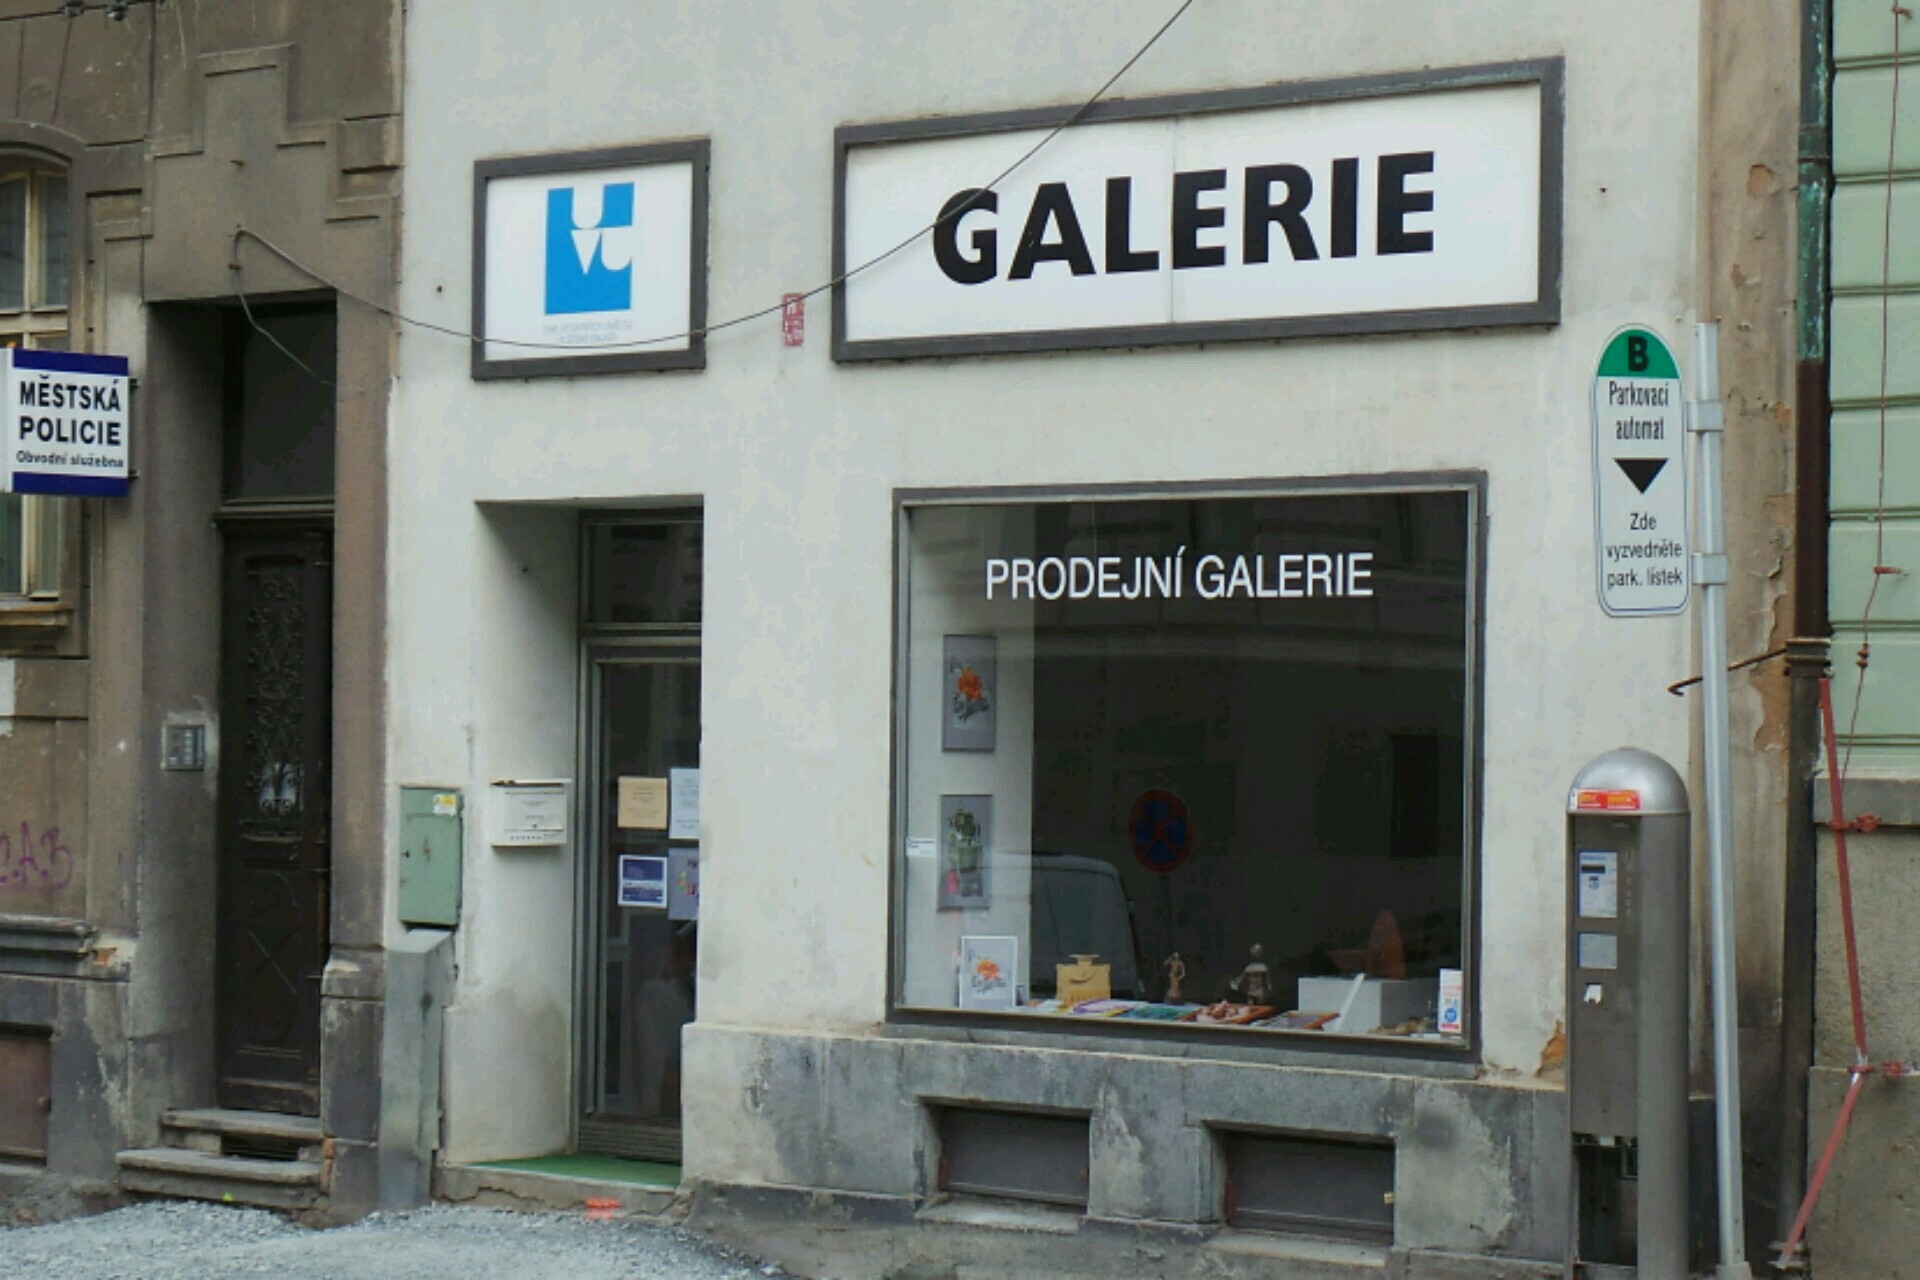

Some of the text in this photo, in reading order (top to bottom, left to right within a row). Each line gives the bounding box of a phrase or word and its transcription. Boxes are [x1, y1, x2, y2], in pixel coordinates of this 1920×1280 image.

[932, 151, 1435, 286] GALERIE
[1627, 335, 1649, 372] B
[19, 374, 122, 412] MĚSTSKÁ
[1608, 380, 1670, 407] Parkovací
[19, 415, 122, 447] POLICIE
[1615, 416, 1665, 441] automat
[1629, 512, 1657, 531] Zde
[1605, 538, 1683, 563] vyzvedněte
[986, 544, 1374, 601] PRODEJNÍ GALERIE
[1606, 567, 1683, 591] park. lístek
